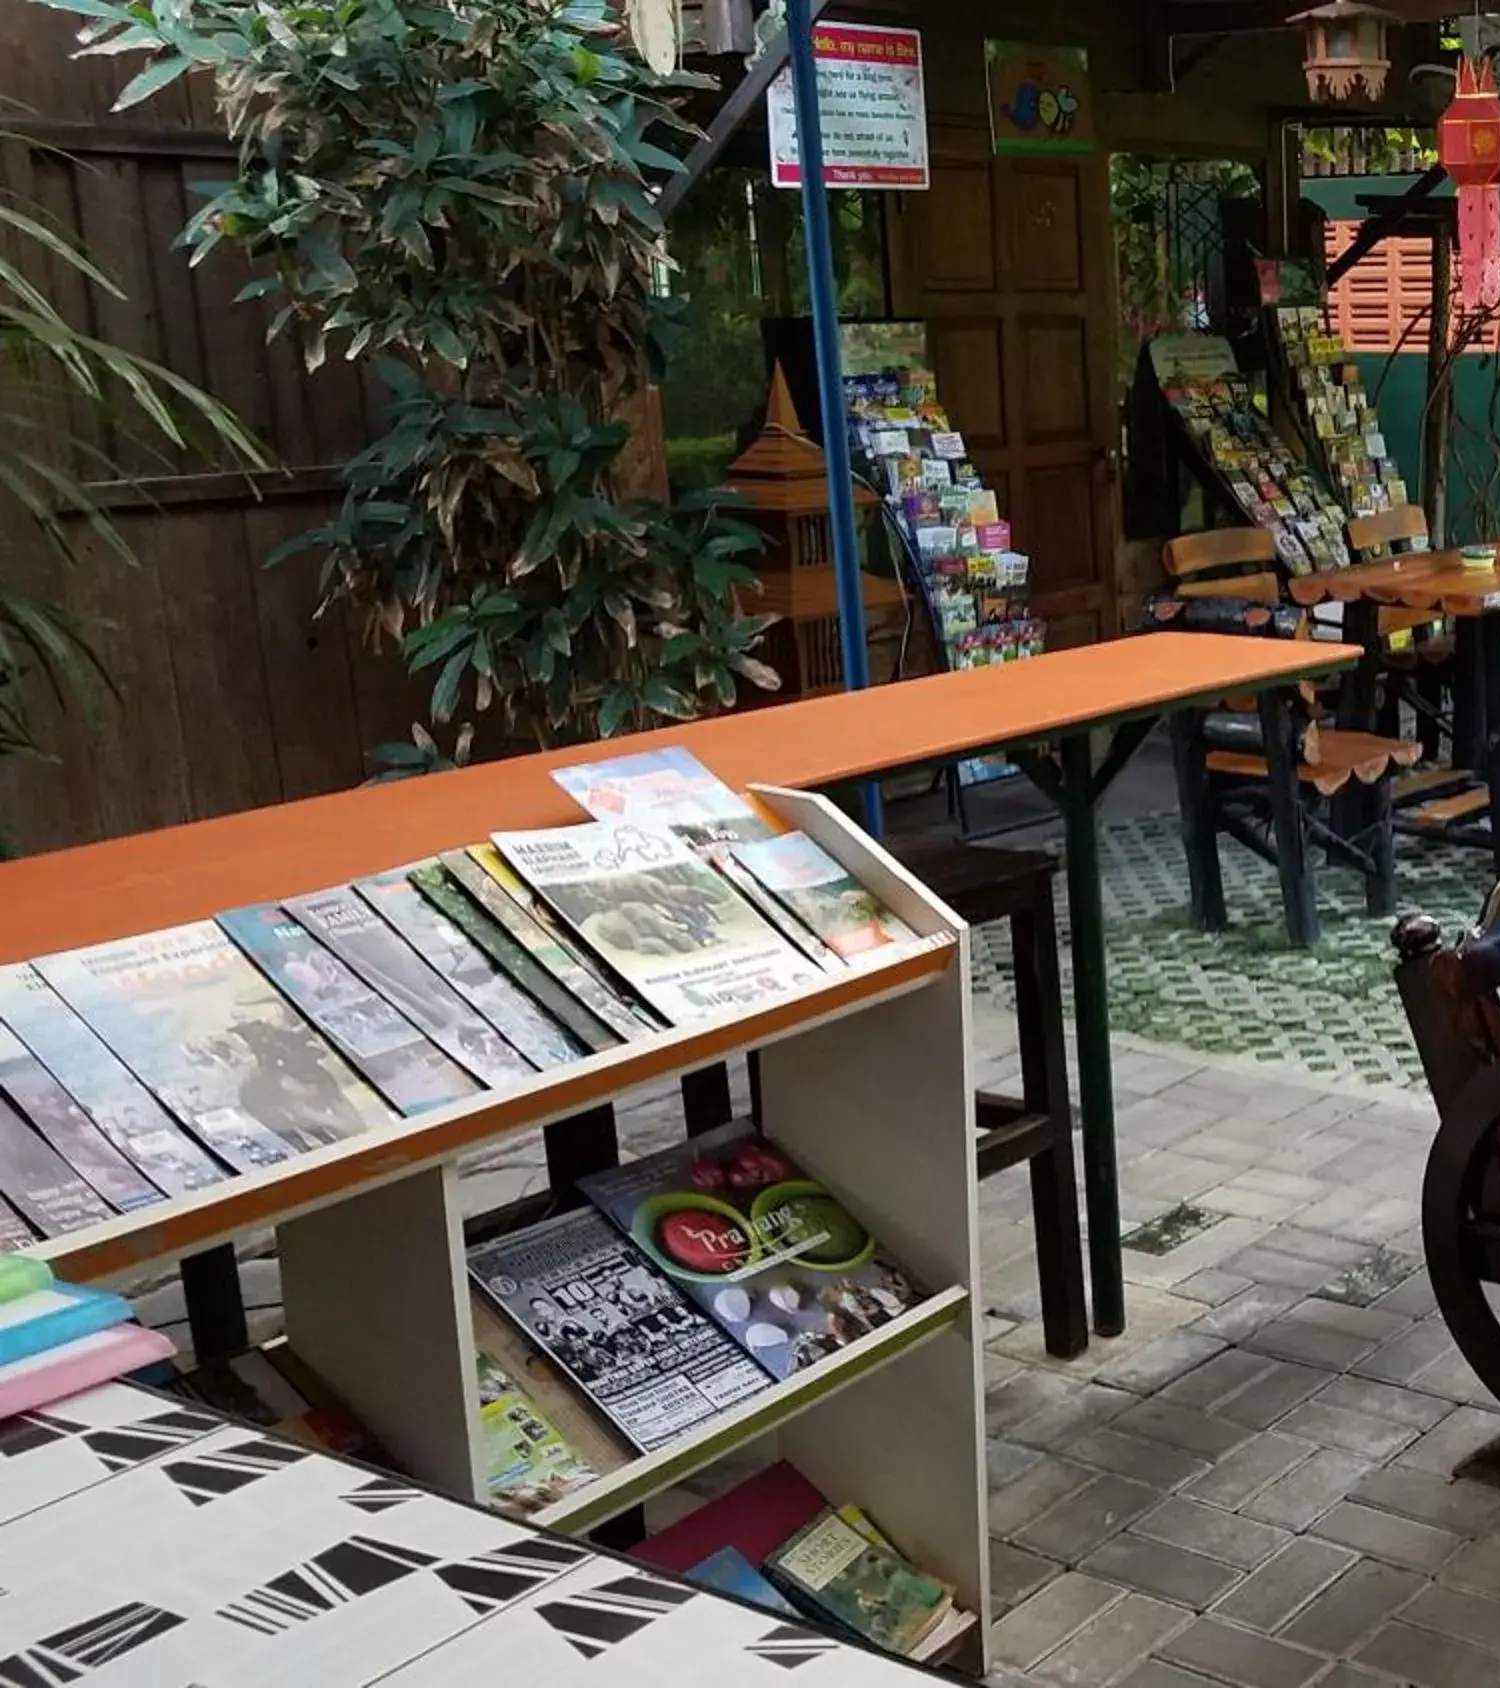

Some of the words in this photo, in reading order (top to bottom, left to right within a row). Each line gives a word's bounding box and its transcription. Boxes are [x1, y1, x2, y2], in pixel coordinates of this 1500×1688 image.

[839, 41, 855, 56] my
[857, 43, 884, 55] name
[885, 40, 895, 56] is
[832, 169, 857, 181] Thank
